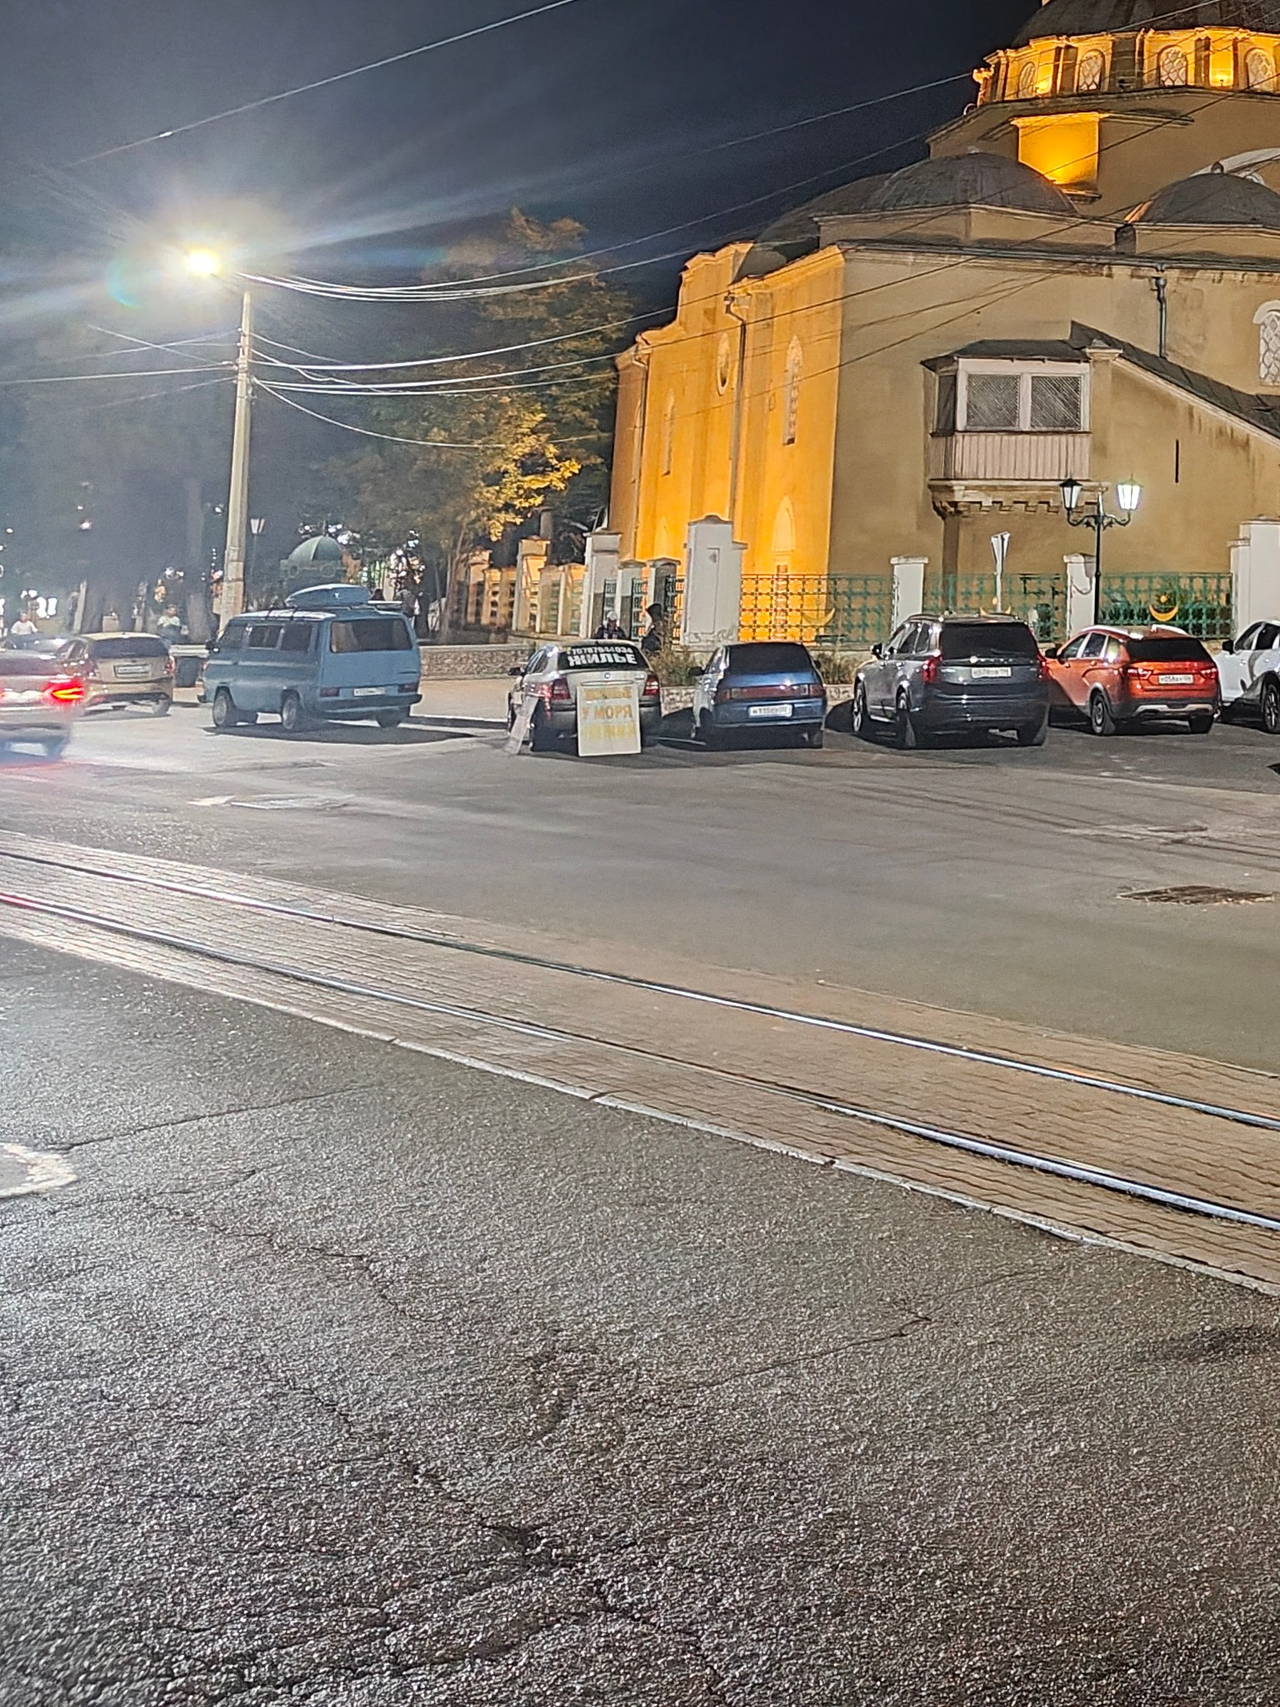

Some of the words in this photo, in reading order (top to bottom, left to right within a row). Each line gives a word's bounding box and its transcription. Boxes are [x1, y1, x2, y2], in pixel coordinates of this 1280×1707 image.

[567, 653, 638, 667] ЖИЛЬЕ
[582, 706, 590, 721] У
[594, 704, 633, 720] МОРЯ
